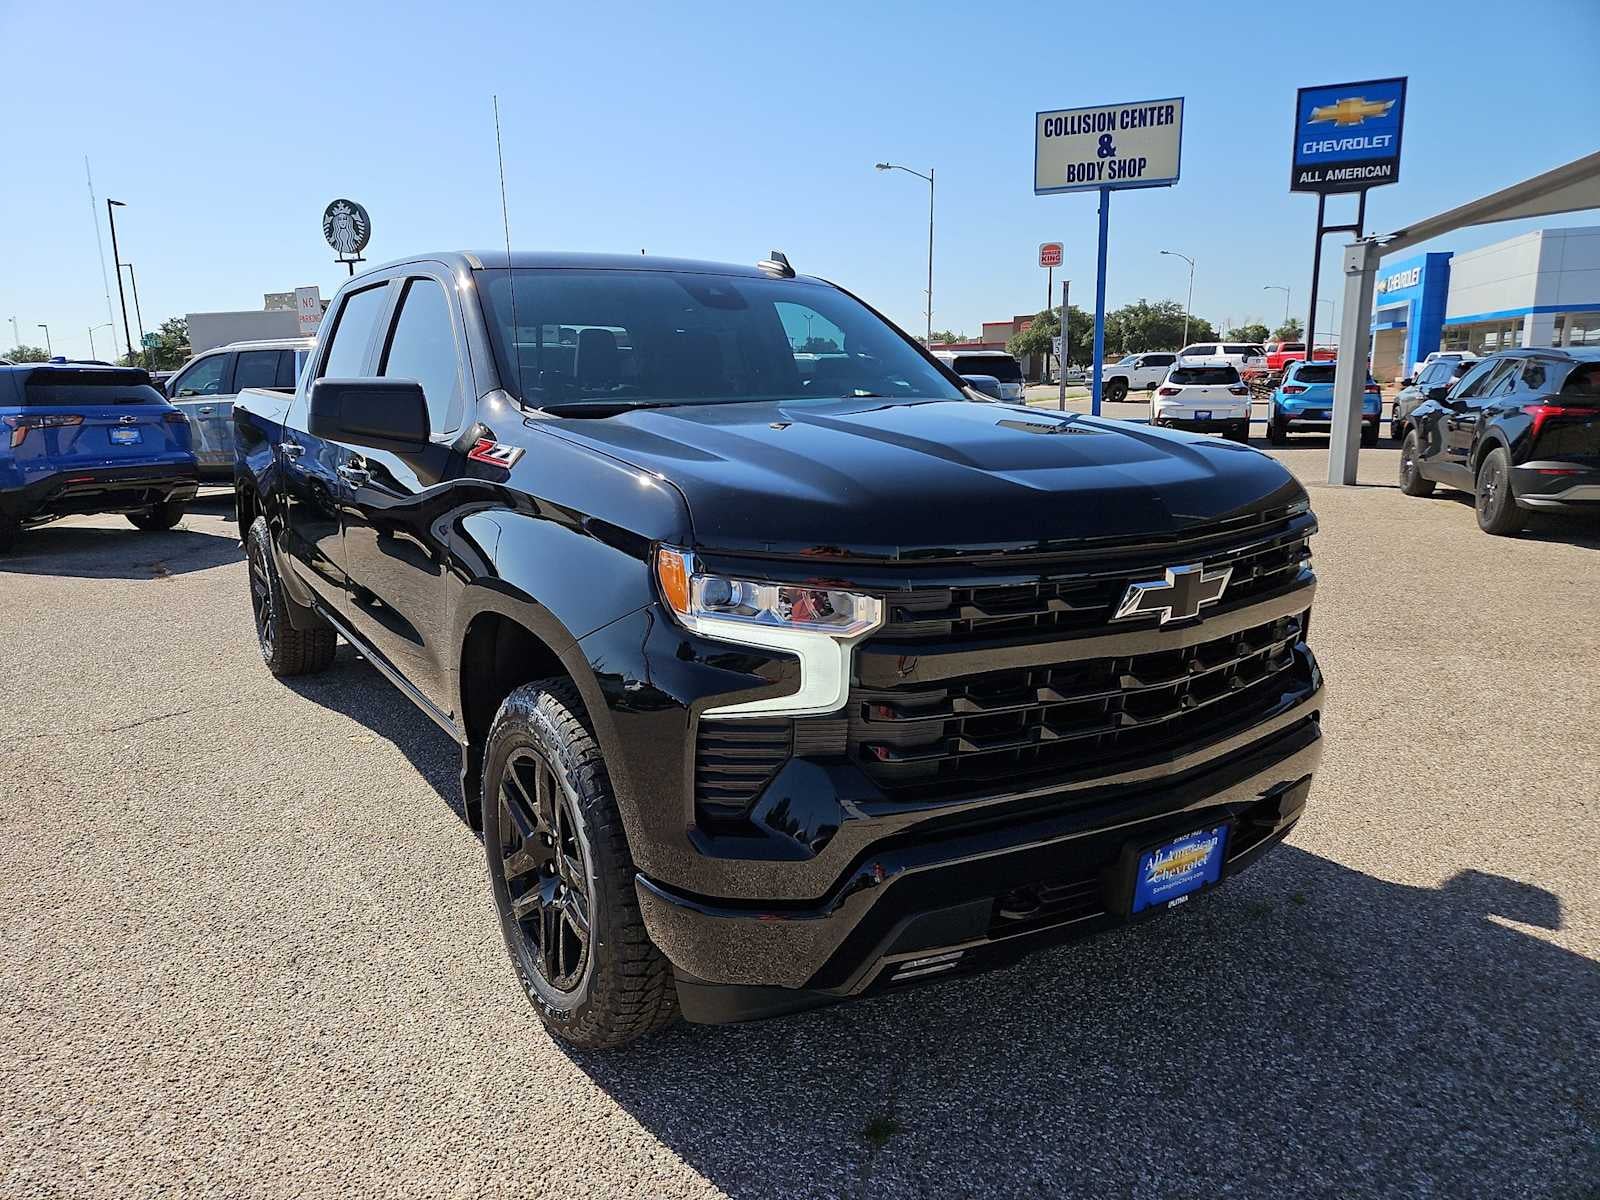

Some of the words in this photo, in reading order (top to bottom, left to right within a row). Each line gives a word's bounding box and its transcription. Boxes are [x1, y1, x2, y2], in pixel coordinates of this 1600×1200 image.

[1044, 112, 1117, 138] COLLISION
[1120, 105, 1175, 130] CENTER
[1097, 133, 1117, 159] &
[1302, 134, 1393, 155] CHEVROLET
[1066, 161, 1105, 183] BODY
[1108, 157, 1147, 180] SHOP
[1299, 171, 1323, 184] ALL
[1325, 165, 1392, 182] AMERICAN
[1041, 255, 1061, 263] KING
[1387, 267, 1421, 292] CHEVROLET
[302, 296, 315, 309] NO
[299, 313, 320, 323] PARKING
[467, 437, 527, 470] Z71
[1166, 837, 1219, 863] American
[1153, 855, 1208, 884] Chevrolet
